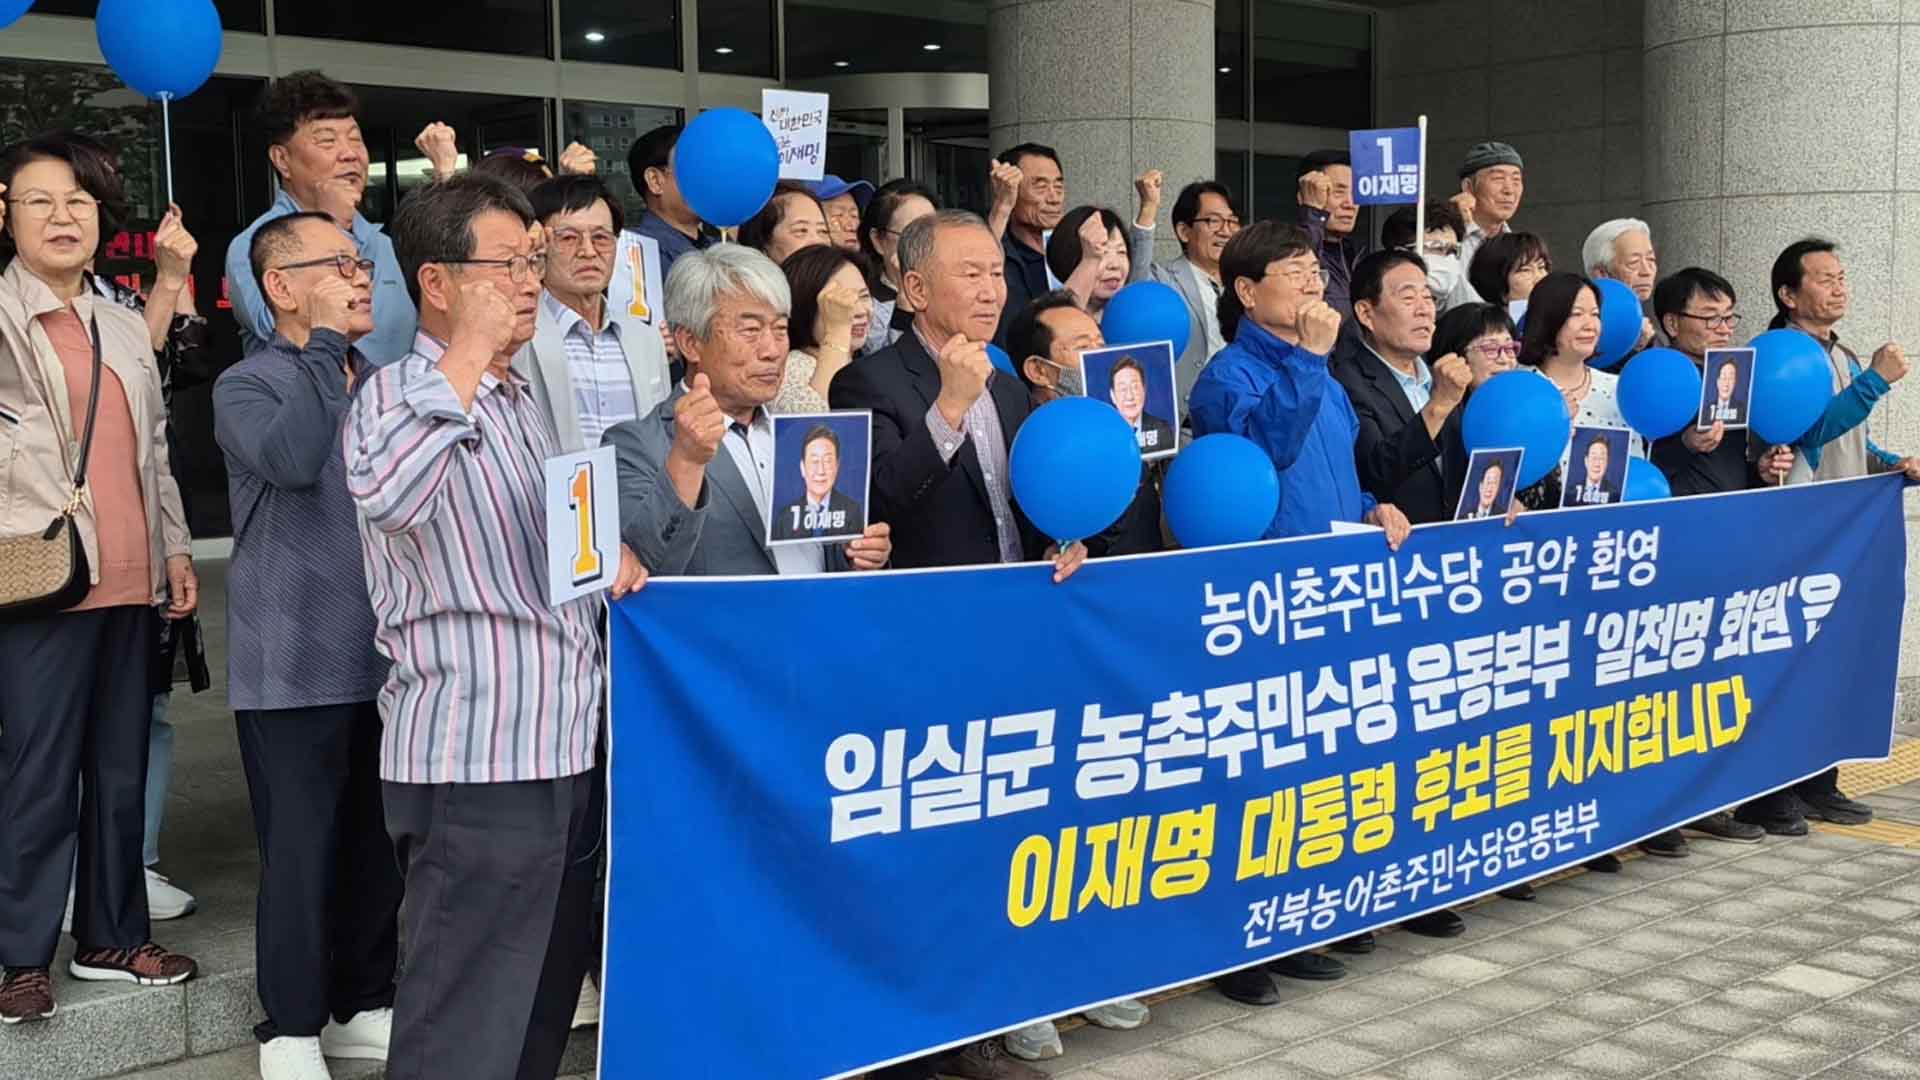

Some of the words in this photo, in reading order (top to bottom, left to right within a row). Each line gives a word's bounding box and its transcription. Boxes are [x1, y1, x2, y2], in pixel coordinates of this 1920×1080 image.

[1358, 174, 1418, 196] 이재명
[1376, 136, 1392, 173] 1
[627, 241, 651, 322] 1
[569, 462, 601, 583] 1
[791, 505, 801, 530] 1
[803, 510, 846, 529] 이재명
[1200, 546, 1483, 656] 농어촌주민수당
[1500, 535, 1577, 604] 공약
[1587, 526, 1661, 591] 환영
[824, 708, 1056, 842] 임실군
[1074, 653, 1398, 800] 농촌주민수당
[1407, 621, 1571, 732] 운동본부
[1006, 802, 1217, 928] 이재명
[1236, 761, 1396, 880] 대통령
[1412, 723, 1533, 830] 후보를
[1548, 675, 1752, 790] 지지합니다
[1243, 797, 1601, 950] 전북농어촌주민수당운동본부
